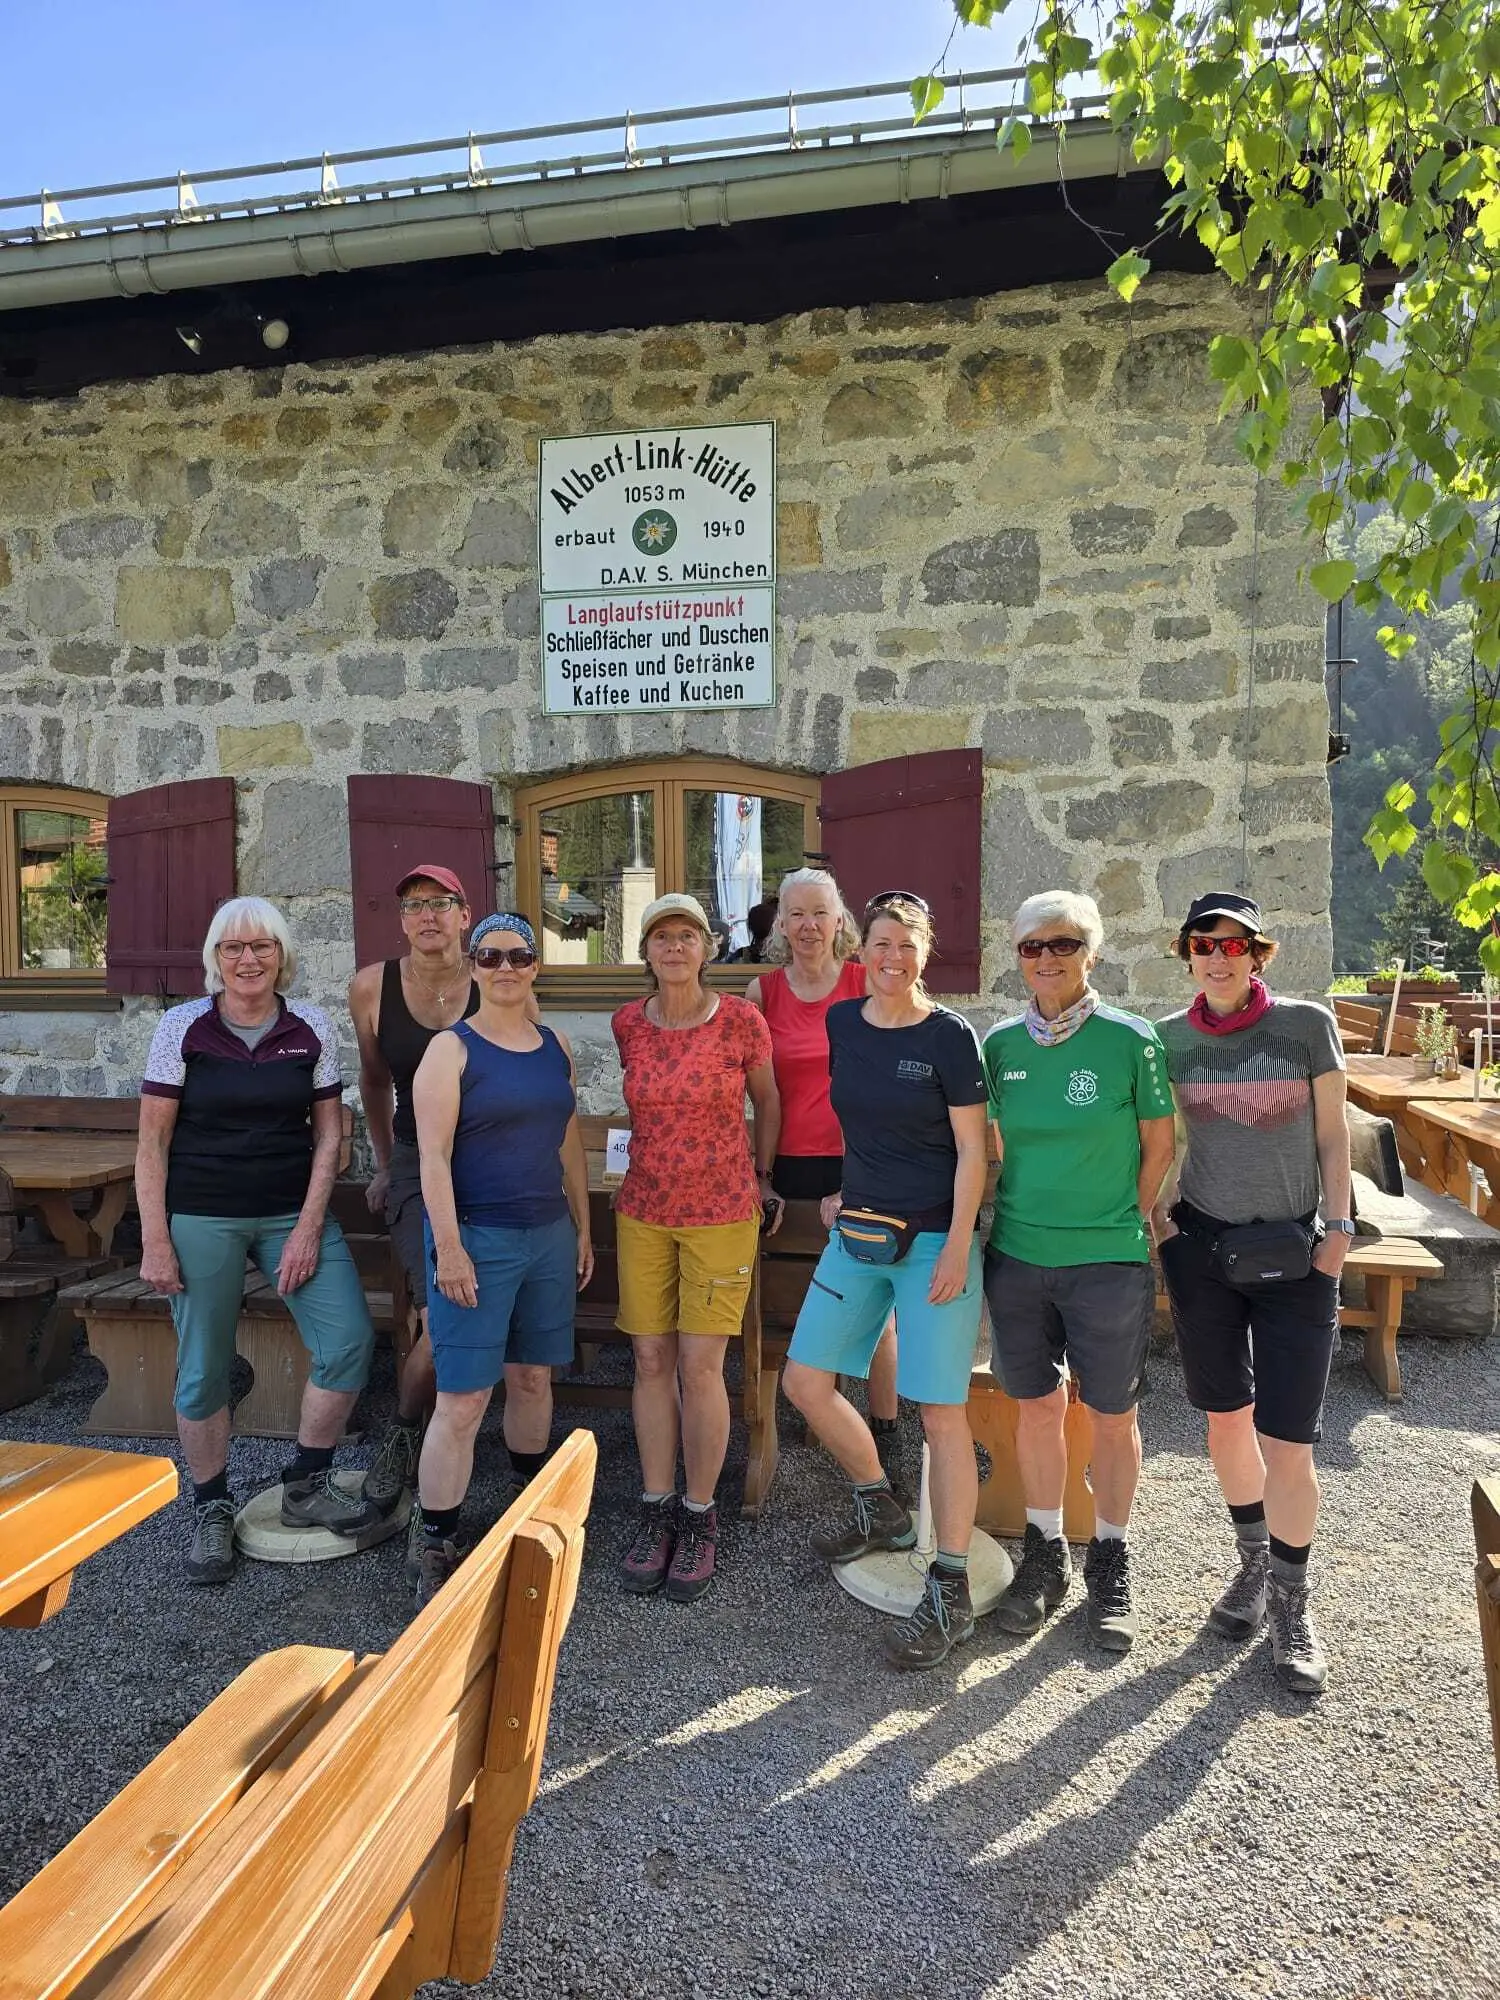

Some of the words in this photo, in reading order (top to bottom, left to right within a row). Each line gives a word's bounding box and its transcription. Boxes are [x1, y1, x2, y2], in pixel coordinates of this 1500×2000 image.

[550, 437, 757, 515] Albert-Link-Hütte
[624, 485, 664, 503] 1053
[668, 488, 685, 500] m
[555, 528, 615, 547] erbaut
[703, 519, 745, 538] 1940
[601, 566, 647, 585] D.A.V.
[657, 565, 673, 582] S.
[682, 561, 767, 581] München
[568, 594, 744, 627] Langlaufstützpunkt
[547, 628, 653, 653] Schließfächer
[662, 625, 691, 647] und
[700, 623, 769, 646] Duschen
[561, 658, 627, 683] Speisen
[635, 655, 666, 676] und
[674, 651, 755, 674] Getränke
[573, 684, 630, 706] Kaffee
[640, 681, 670, 704] und
[680, 680, 744, 702] Kuchen
[1003, 1070, 1027, 1081] JAKO
